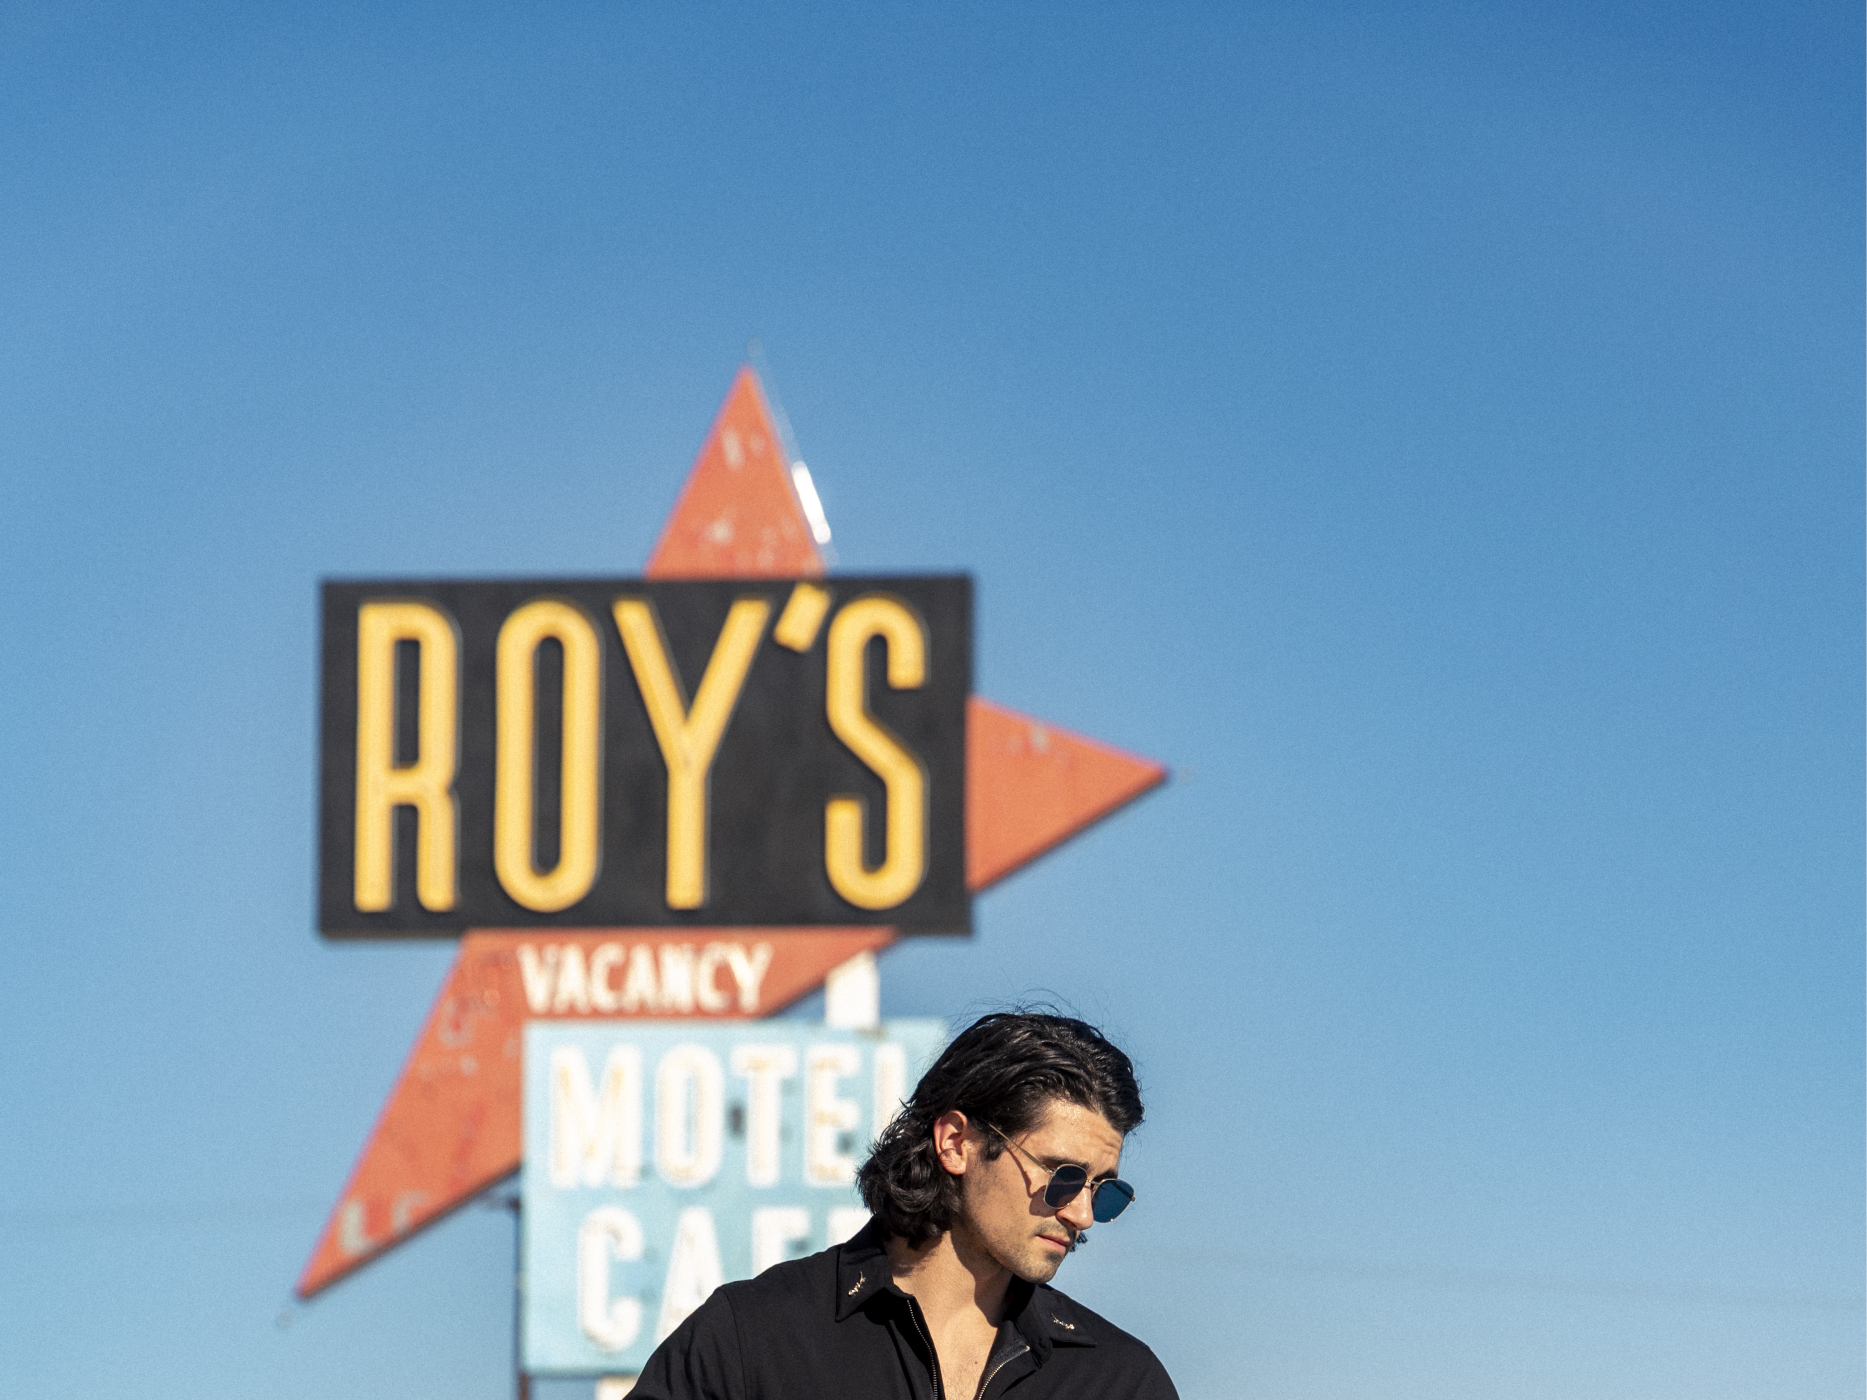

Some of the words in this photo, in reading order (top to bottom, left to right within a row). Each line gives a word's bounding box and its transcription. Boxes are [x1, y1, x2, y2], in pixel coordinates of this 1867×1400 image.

[354, 582, 926, 912] ROY'S
[516, 941, 774, 1014] VACANCY
[577, 1204, 876, 1352] CA
